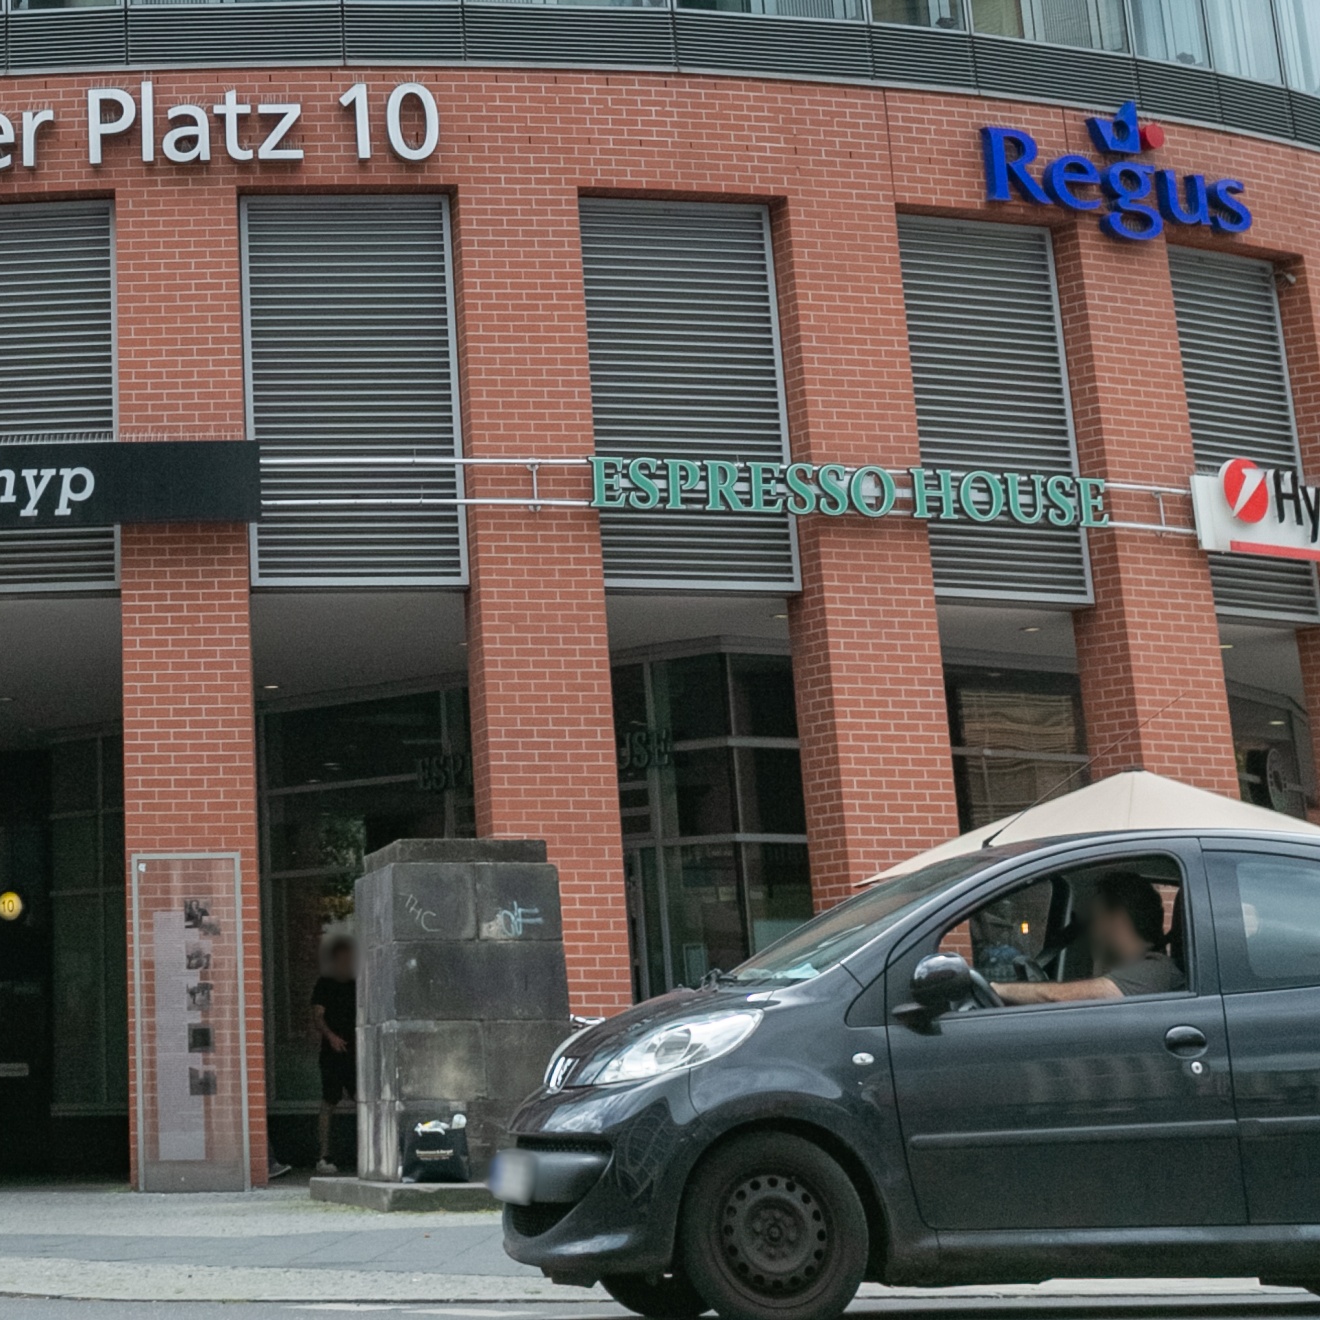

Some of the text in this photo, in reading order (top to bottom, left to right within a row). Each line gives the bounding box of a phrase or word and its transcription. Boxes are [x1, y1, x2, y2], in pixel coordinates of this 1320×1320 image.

[87, 81, 304, 165] Platz
[339, 82, 440, 161] 10
[980, 126, 1253, 240] Regus
[588, 456, 1110, 528] ESPRESSO HOUSE
[2, 899, 14, 913] 10
